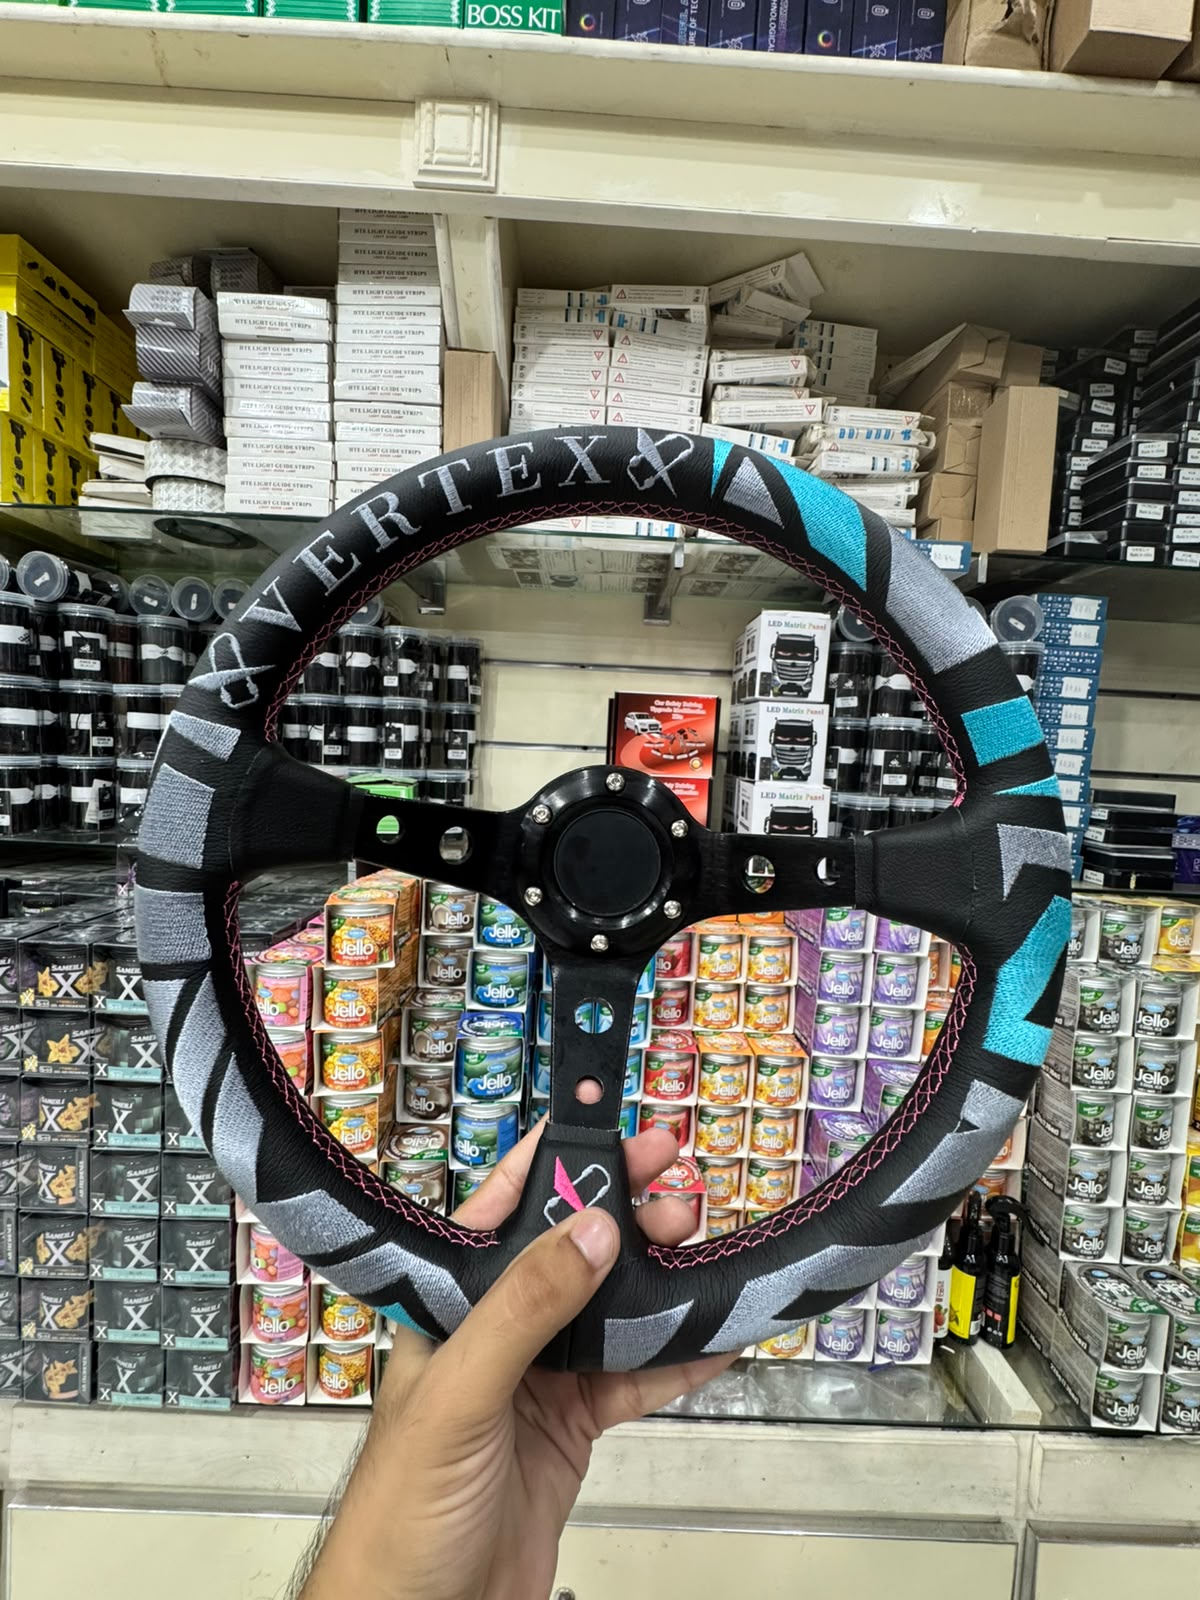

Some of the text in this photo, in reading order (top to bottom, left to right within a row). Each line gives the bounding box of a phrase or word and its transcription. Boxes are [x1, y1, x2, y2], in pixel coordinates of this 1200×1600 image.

[467, 4, 561, 30] BOSS KIT
[239, 434, 612, 633] VERTEX
[768, 620, 782, 628] LED
[784, 621, 806, 629] Matrix
[783, 706, 804, 715] Matrix
[806, 707, 824, 716] Panel
[761, 791, 824, 801] LED Matrix Panel
[442, 912, 470, 926] Jello
[489, 925, 520, 939] Jello
[904, 933, 919, 945] Jel
[339, 942, 374, 955] Jello
[1115, 941, 1142, 956] Jello
[434, 966, 462, 979] Jello
[53, 972, 84, 998] X
[116, 975, 142, 1000] X
[484, 985, 514, 999] Jello
[826, 981, 854, 995] Jello
[885, 984, 912, 997] Jello
[257, 1002, 280, 1016] ello
[332, 1003, 366, 1018] Jello
[656, 1005, 681, 1019] Jello
[1136, 1011, 1169, 1028] Jello
[423, 1041, 453, 1054] Jello
[823, 1034, 850, 1047] Jello
[875, 1035, 904, 1050] Jello
[72, 1034, 105, 1064] X
[131, 1043, 162, 1068] X
[330, 1066, 365, 1080] Jello
[1084, 1066, 1115, 1080] Jello
[1135, 1068, 1169, 1086] Jello
[478, 1074, 512, 1090] Jello
[658, 1079, 685, 1093] Jello
[823, 1086, 850, 1099] Jello
[112, 1109, 132, 1134] X
[1096, 1124, 1113, 1139] Jel
[1154, 1127, 1171, 1142] Jel
[711, 1134, 736, 1146] Jello
[755, 1135, 783, 1150] Jello
[665, 1167, 689, 1178] ello
[127, 1173, 159, 1202] X
[186, 1180, 216, 1204] X
[760, 1185, 786, 1200] Jello
[1069, 1177, 1103, 1194] Jello
[1134, 1180, 1166, 1196] Jello
[1073, 1236, 1104, 1250] Jello
[45, 1240, 75, 1266] X
[124, 1238, 156, 1268] X
[186, 1246, 216, 1271] X
[885, 1284, 916, 1300] Jello
[124, 1304, 154, 1330] X
[257, 1317, 290, 1332] Jello
[330, 1315, 365, 1330] Jello
[191, 1313, 220, 1338] X
[824, 1336, 854, 1352] Jello
[879, 1336, 910, 1353] Jello
[193, 1371, 221, 1397] X
[260, 1376, 295, 1394] Jello
[1107, 1402, 1140, 1417] Jello
